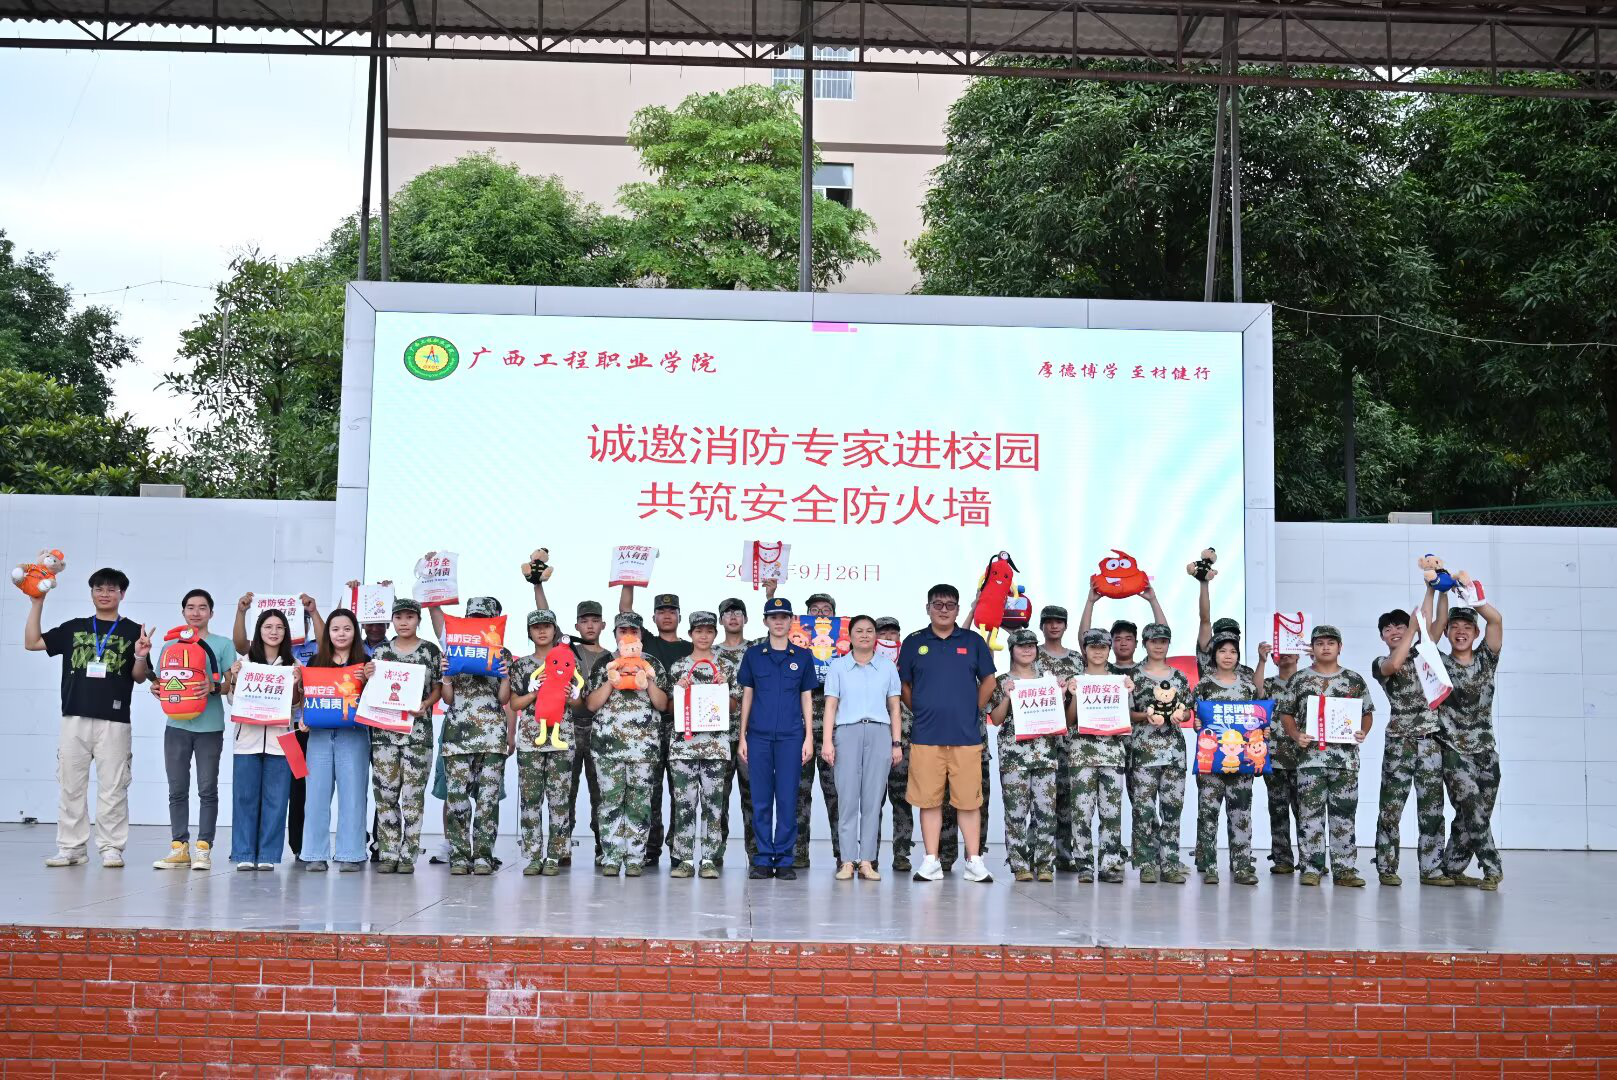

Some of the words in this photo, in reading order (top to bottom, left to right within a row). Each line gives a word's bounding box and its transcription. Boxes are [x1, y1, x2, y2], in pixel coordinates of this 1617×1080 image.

[467, 346, 717, 374] 广西工程职业学院
[1038, 361, 1118, 379] 厚德博学
[587, 423, 1040, 472] 诚邀消防专家进校园
[637, 481, 992, 528] 共筑安全防火墙
[618, 551, 649, 561] 人人有责
[257, 598, 296, 608] 消防安全
[244, 672, 286, 684] 消防安全
[242, 683, 285, 695] 人人有责
[1018, 686, 1056, 699] 消防安全
[1082, 684, 1120, 695] 消防安全
[1020, 696, 1057, 710] 人人有责
[1083, 694, 1120, 704] 人人有责
[1212, 703, 1255, 715] 全民消防
